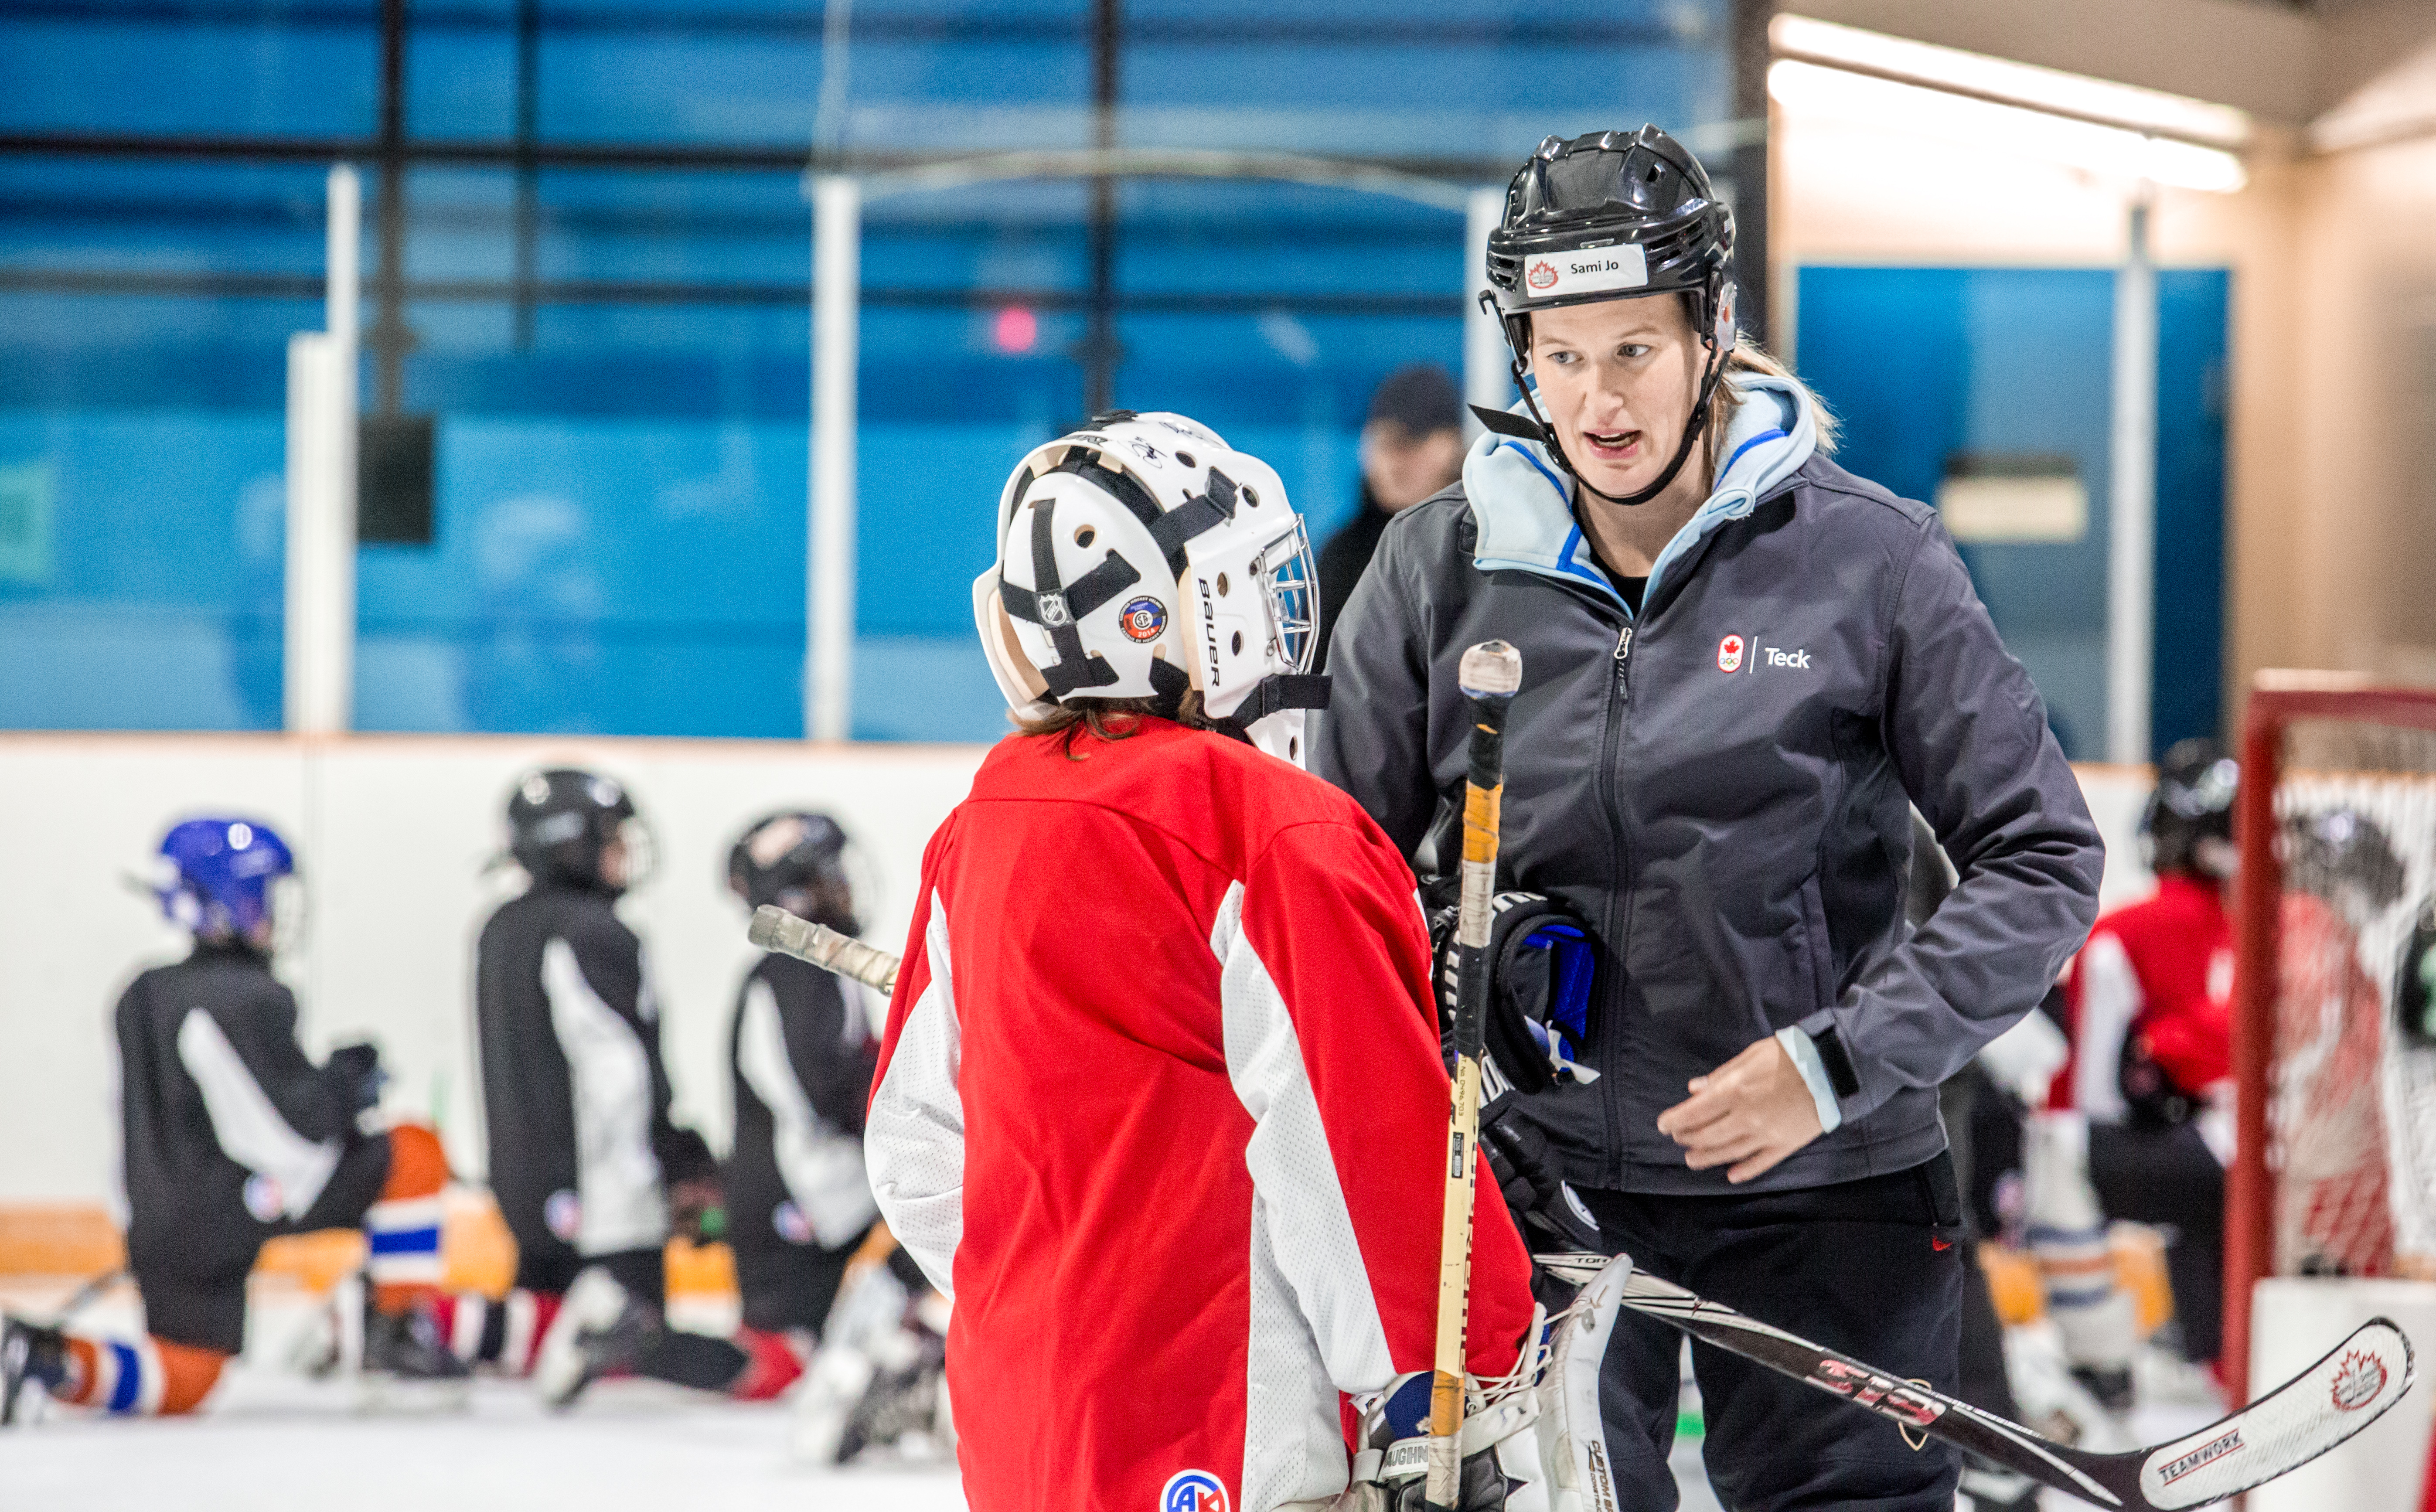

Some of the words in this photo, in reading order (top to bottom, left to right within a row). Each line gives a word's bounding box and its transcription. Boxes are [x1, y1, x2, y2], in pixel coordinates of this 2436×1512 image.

[1571, 260, 1601, 274] Sami
[1605, 260, 1618, 271] Jo
[1047, 603, 1058, 620] NHL
[1138, 628, 1155, 637] 2014
[1765, 647, 1811, 668] Teck
[1383, 1445, 1428, 1468] AUGHN
[2159, 1432, 2242, 1481] TEAMWORK
[1592, 1440, 1611, 1497] CUSTOM
